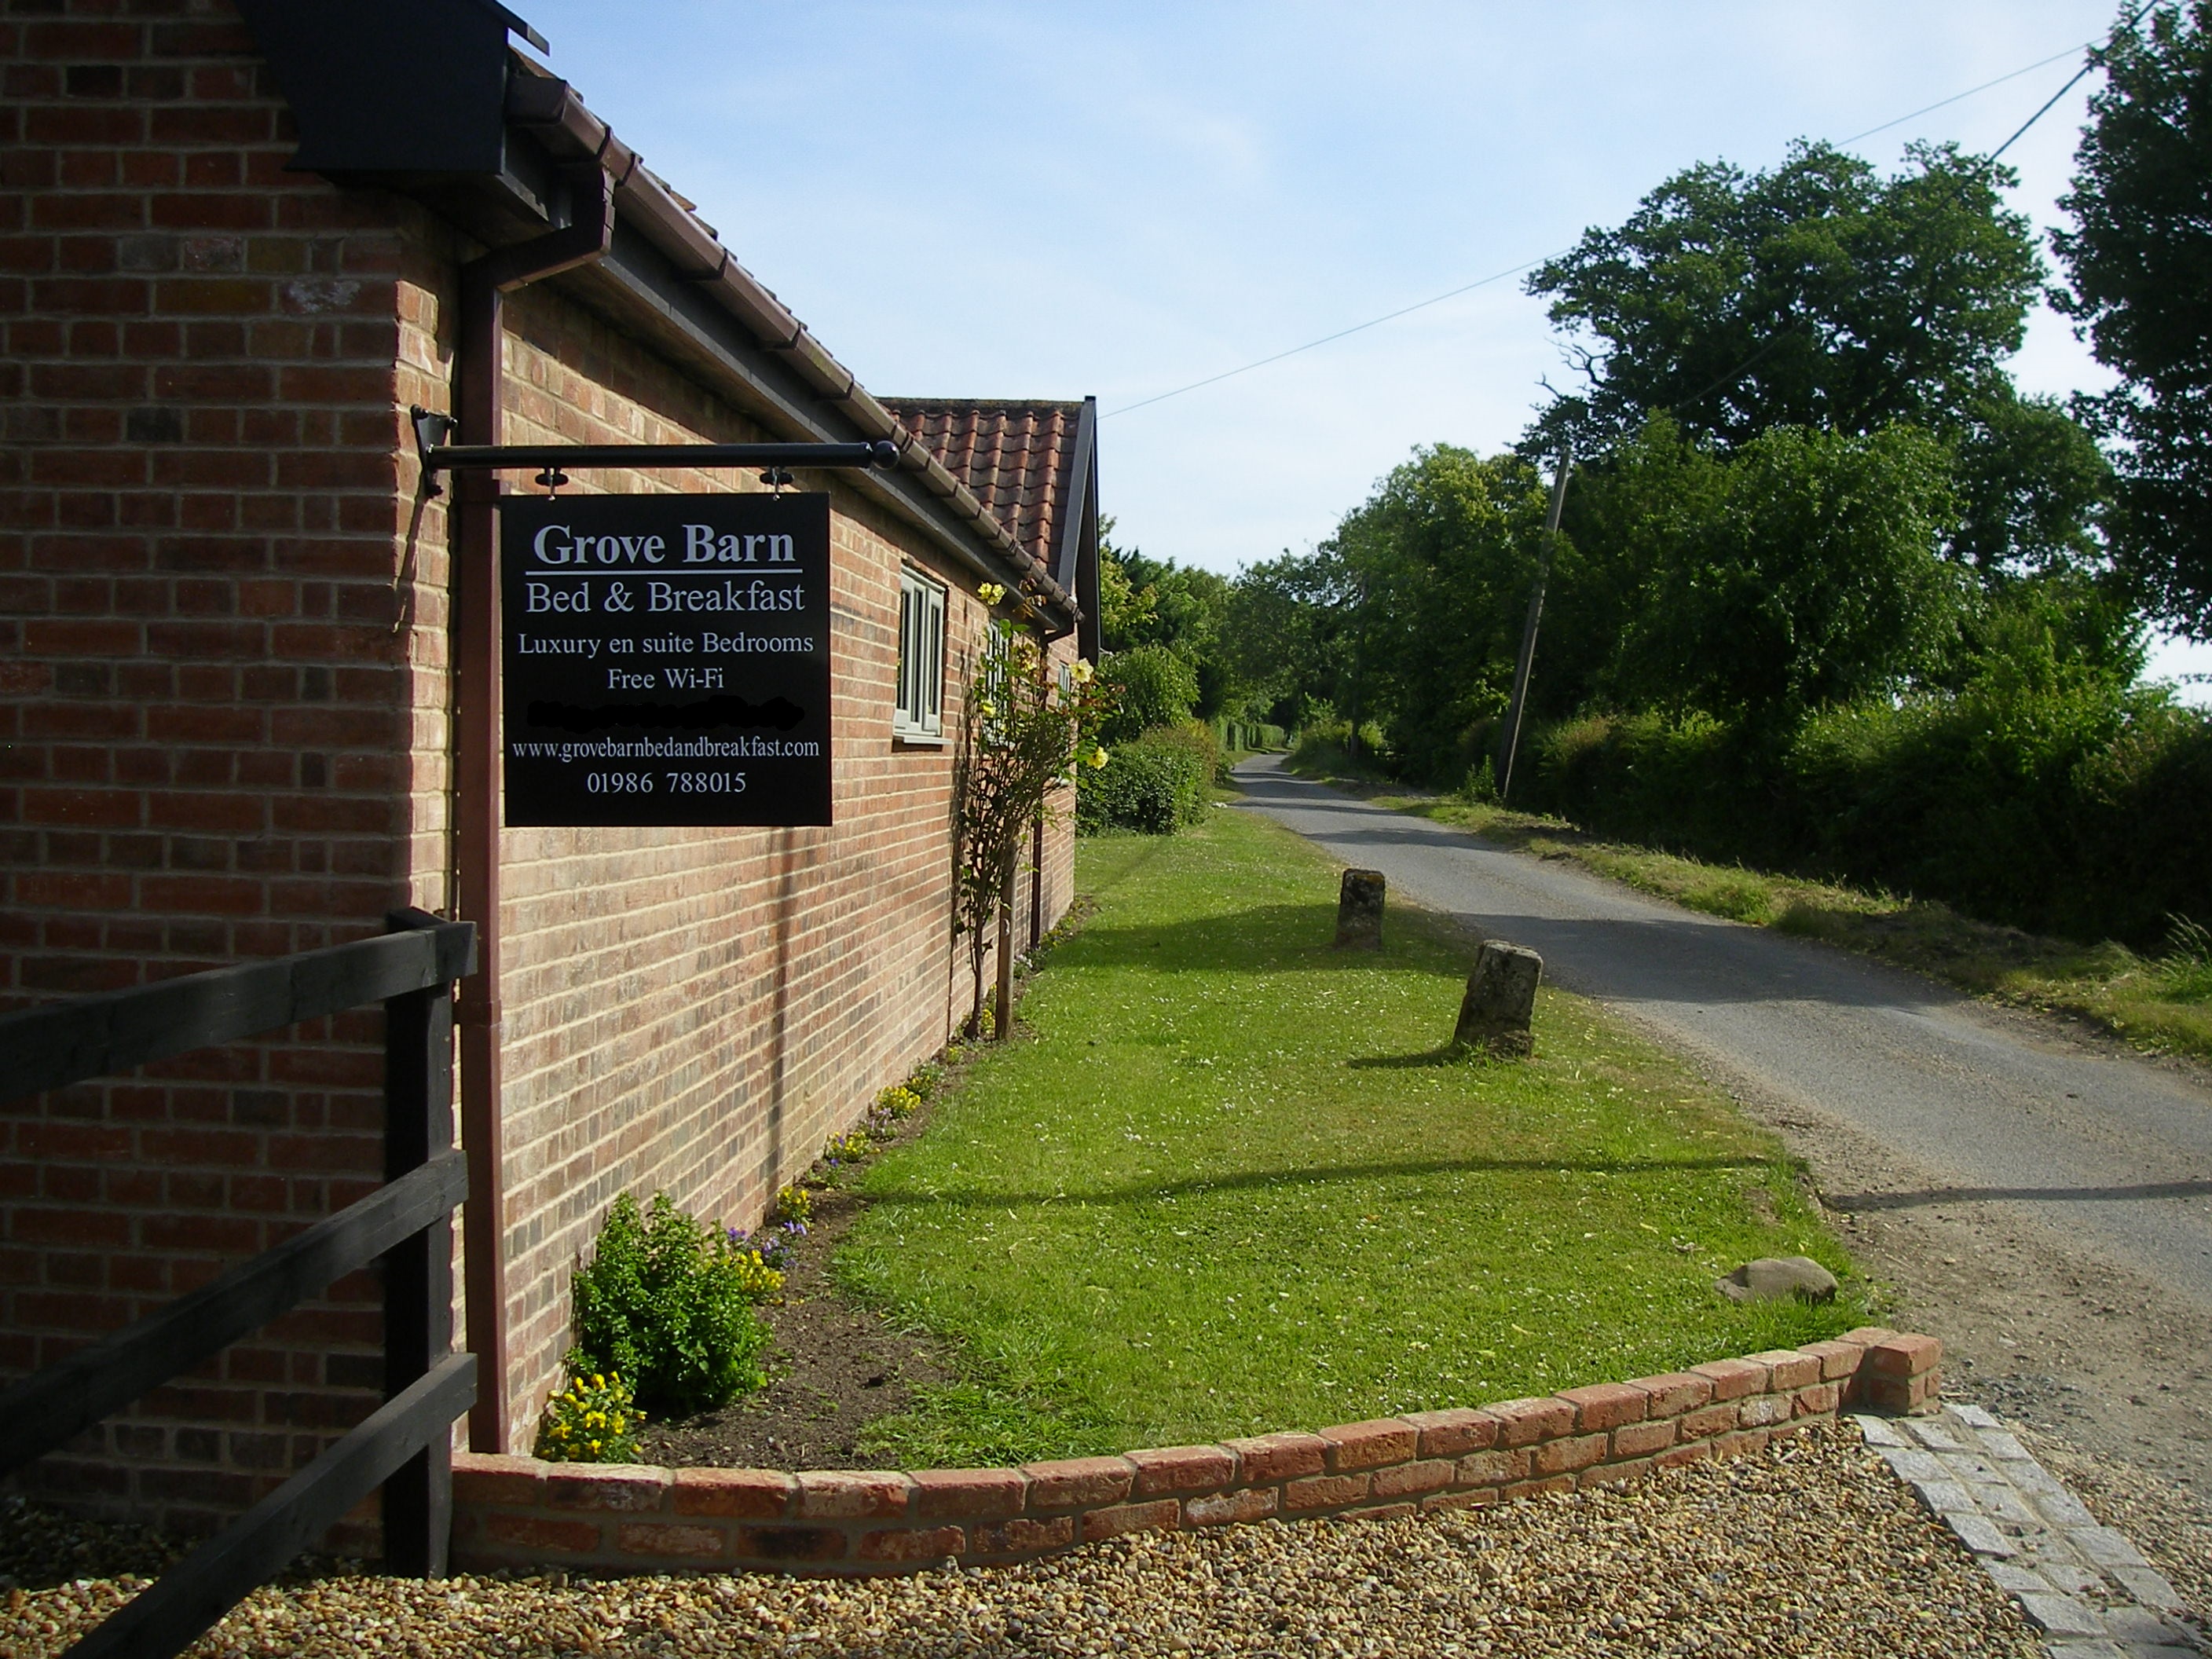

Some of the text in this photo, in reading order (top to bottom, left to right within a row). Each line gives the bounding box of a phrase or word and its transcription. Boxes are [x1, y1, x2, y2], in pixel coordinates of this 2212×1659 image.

[534, 525, 795, 564] Grove Barn
[526, 580, 804, 612] Bed & Breakfast
[519, 632, 813, 658] Luxury en suite Bedrooms
[609, 668, 723, 688] Free Wi-Fi
[513, 736, 819, 762] www.grovebarnbedandbreakfast.com
[588, 773, 745, 793] 01986 788015
